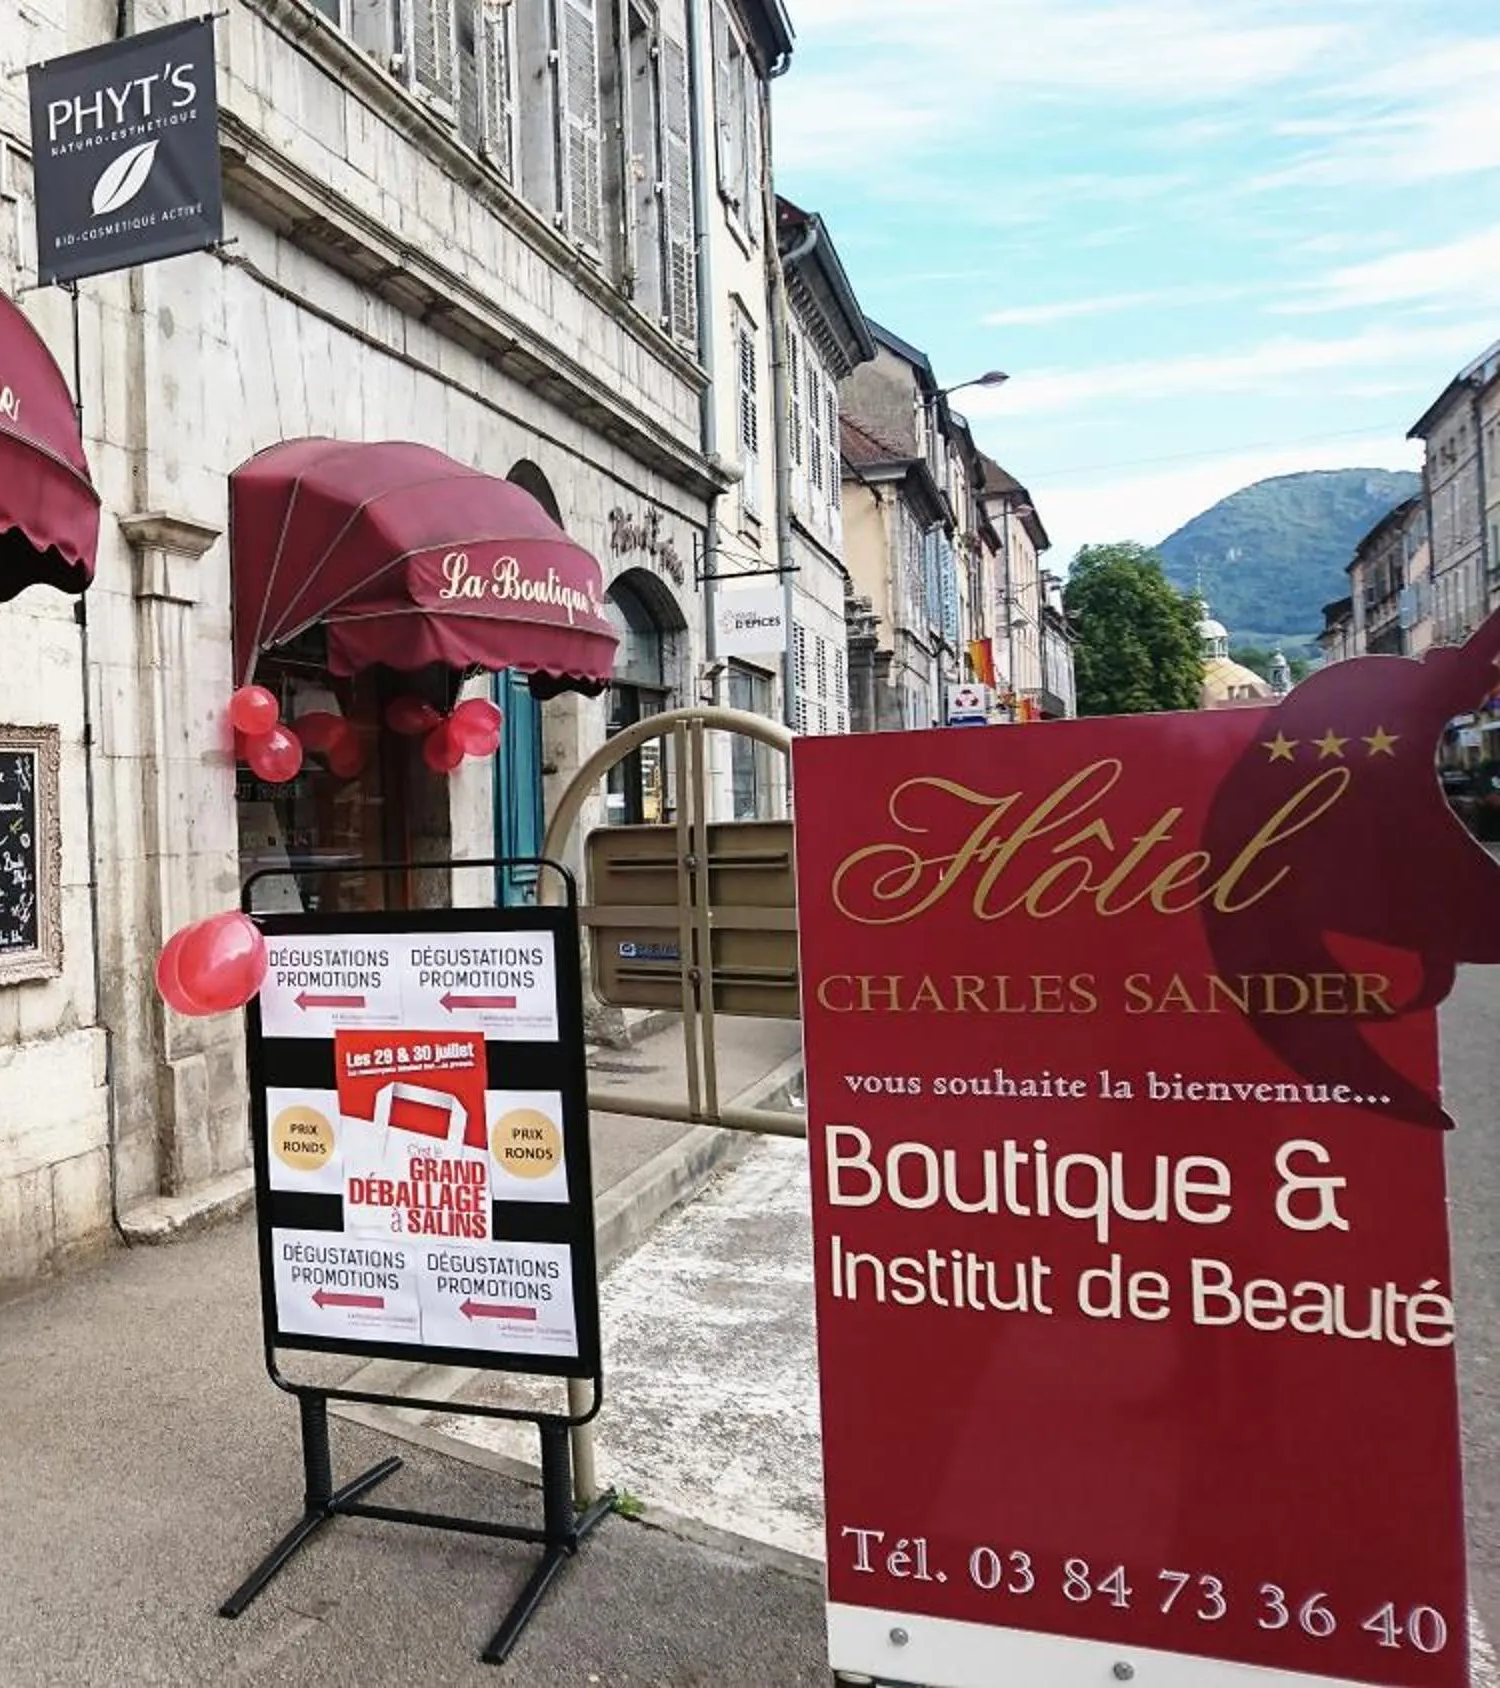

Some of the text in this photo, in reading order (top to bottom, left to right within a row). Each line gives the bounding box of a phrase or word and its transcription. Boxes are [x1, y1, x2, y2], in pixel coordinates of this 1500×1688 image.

[49, 63, 198, 141] PHYT'S
[440, 552, 489, 599] La
[832, 758, 1351, 924] Hôtel
[269, 947, 389, 968] DÉGUSTATIONS
[411, 945, 544, 968] DÉGUSTATIONS
[276, 970, 382, 989] PROMOTIONS
[419, 969, 536, 989] PROMOTIONS
[816, 973, 1397, 1016] CHARLES SANDER
[346, 1052, 371, 1068] Les
[397, 1047, 410, 1063] &
[413, 1045, 431, 1062] 30
[435, 1042, 475, 1061] juillet
[845, 1069, 1392, 1106] vous souhaite la bienvenue...
[289, 1123, 319, 1136] PRIX
[512, 1128, 544, 1141] PRIX
[283, 1140, 327, 1156] RONDS
[505, 1147, 553, 1162] RONDS
[409, 1157, 486, 1185] GRAND
[825, 1123, 1349, 1244] Boutique &
[349, 1173, 487, 1214] DÉBALLAGE
[391, 1207, 488, 1240] à SALINS
[283, 1240, 405, 1270] DÉGUSTATIONS
[427, 1250, 560, 1280] DÉGUSTATIONS
[291, 1269, 400, 1291] PROMOTIONS
[437, 1277, 553, 1301] PROMOTIONS
[832, 1235, 1454, 1347] Institut de Beauté
[842, 1526, 1448, 1655] Tél. 03 84 73 36 40
